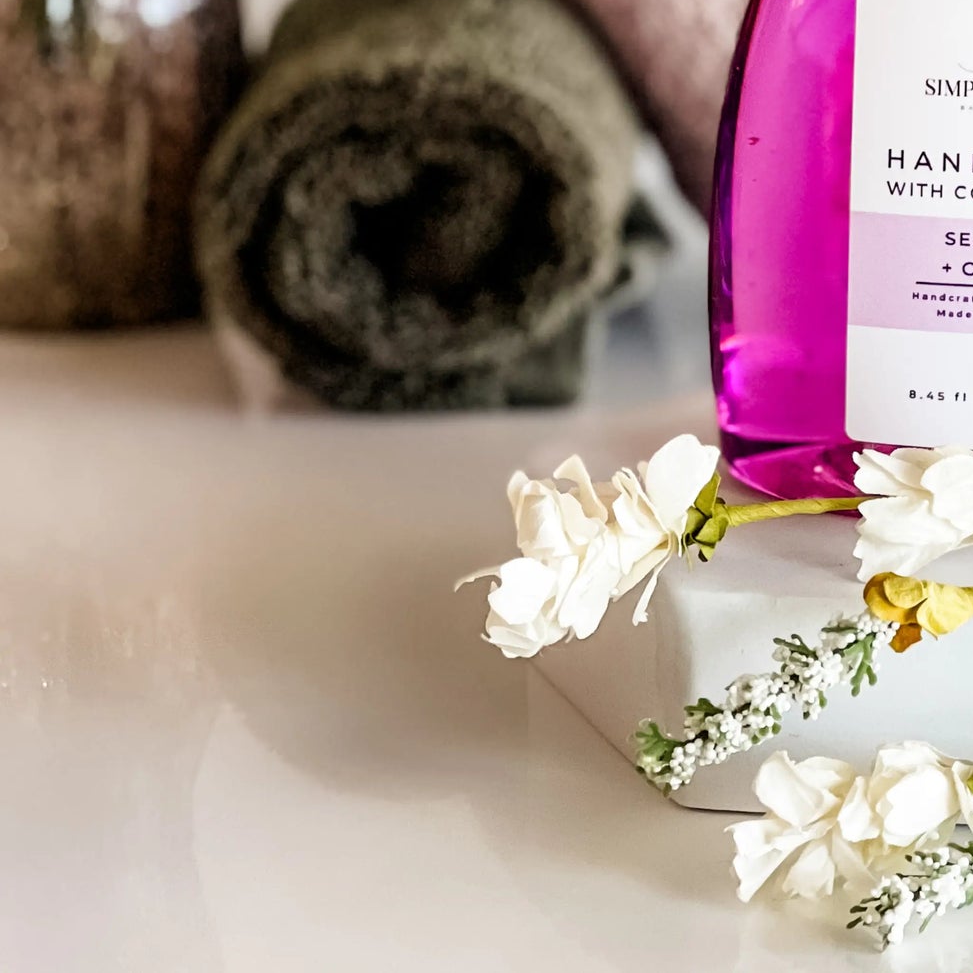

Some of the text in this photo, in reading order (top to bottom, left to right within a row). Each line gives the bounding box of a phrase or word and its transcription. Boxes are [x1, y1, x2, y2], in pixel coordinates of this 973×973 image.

[886, 181, 944, 198] WITH
[937, 309, 973, 319] Made
[909, 390, 945, 401] 8.45
[955, 392, 967, 402] fl
